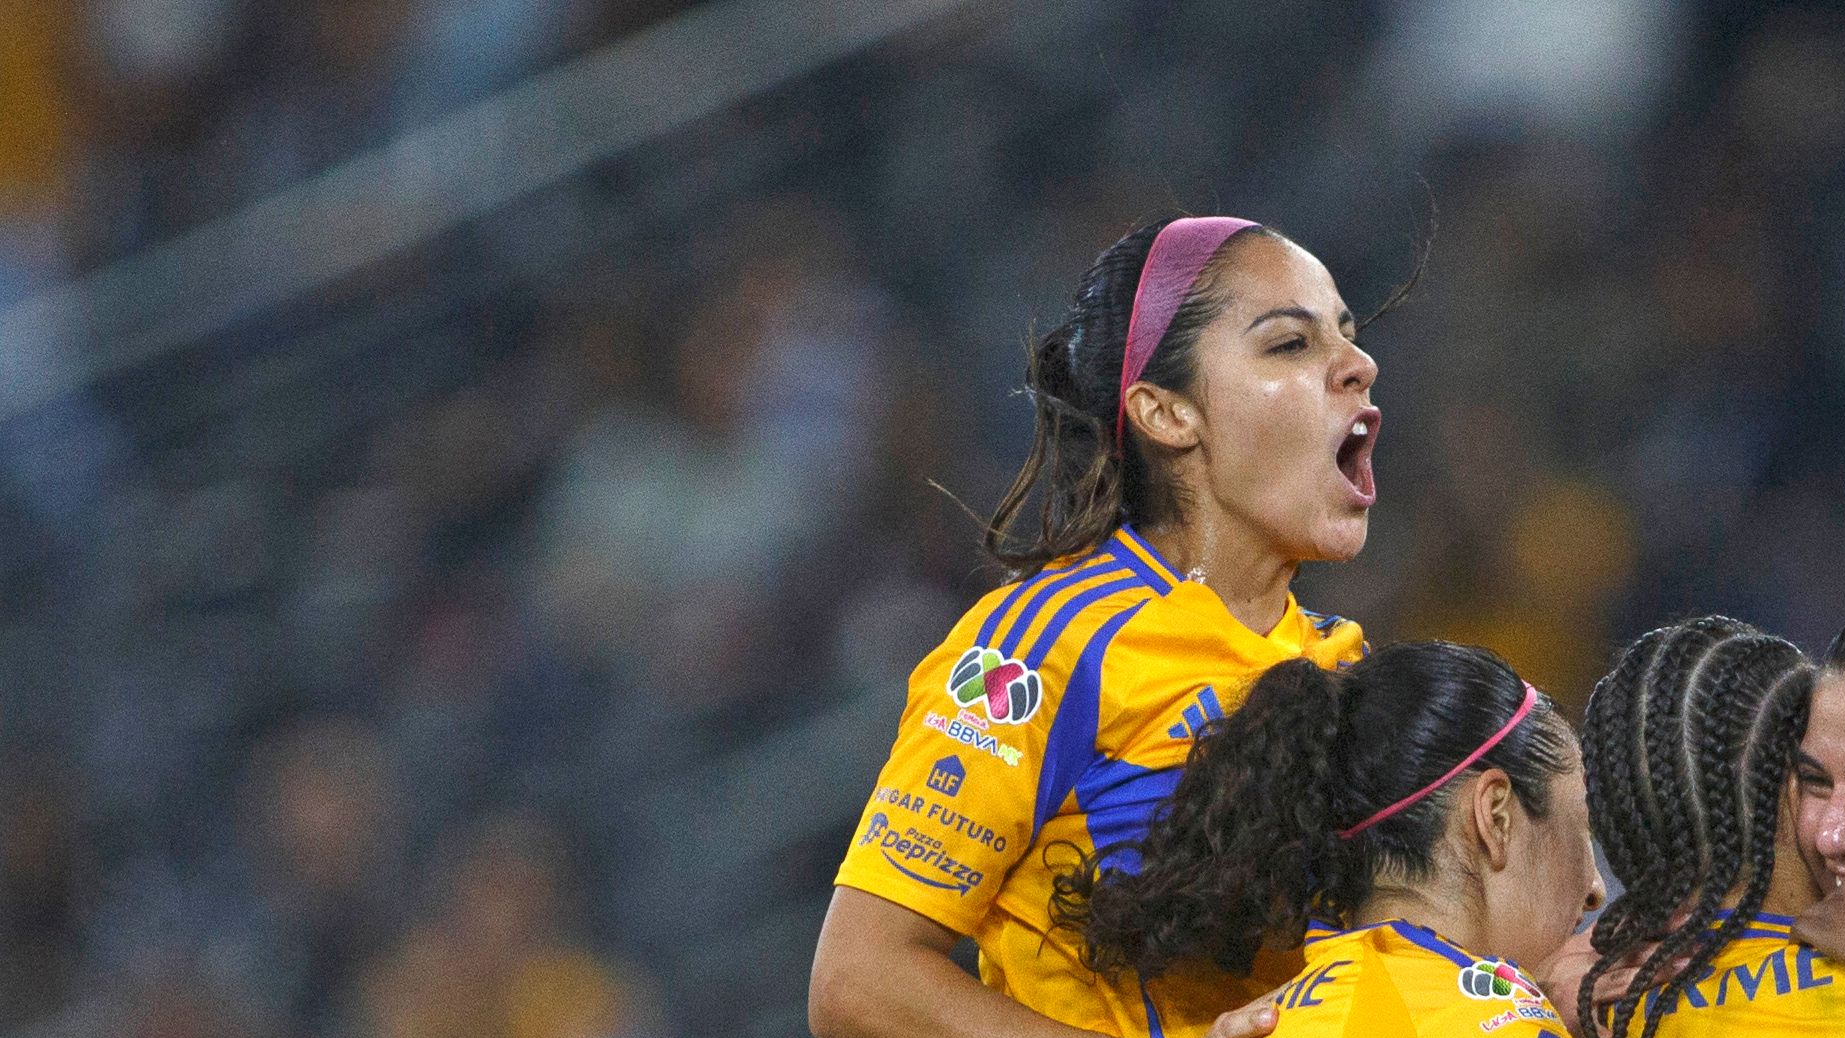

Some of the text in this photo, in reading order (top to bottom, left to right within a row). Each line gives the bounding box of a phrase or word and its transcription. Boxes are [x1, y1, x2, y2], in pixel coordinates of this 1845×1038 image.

[948, 720, 998, 754] BBVA
[930, 768, 960, 792] HF
[927, 803, 1007, 852] FUTURO
[880, 829, 984, 887] Deprizza
